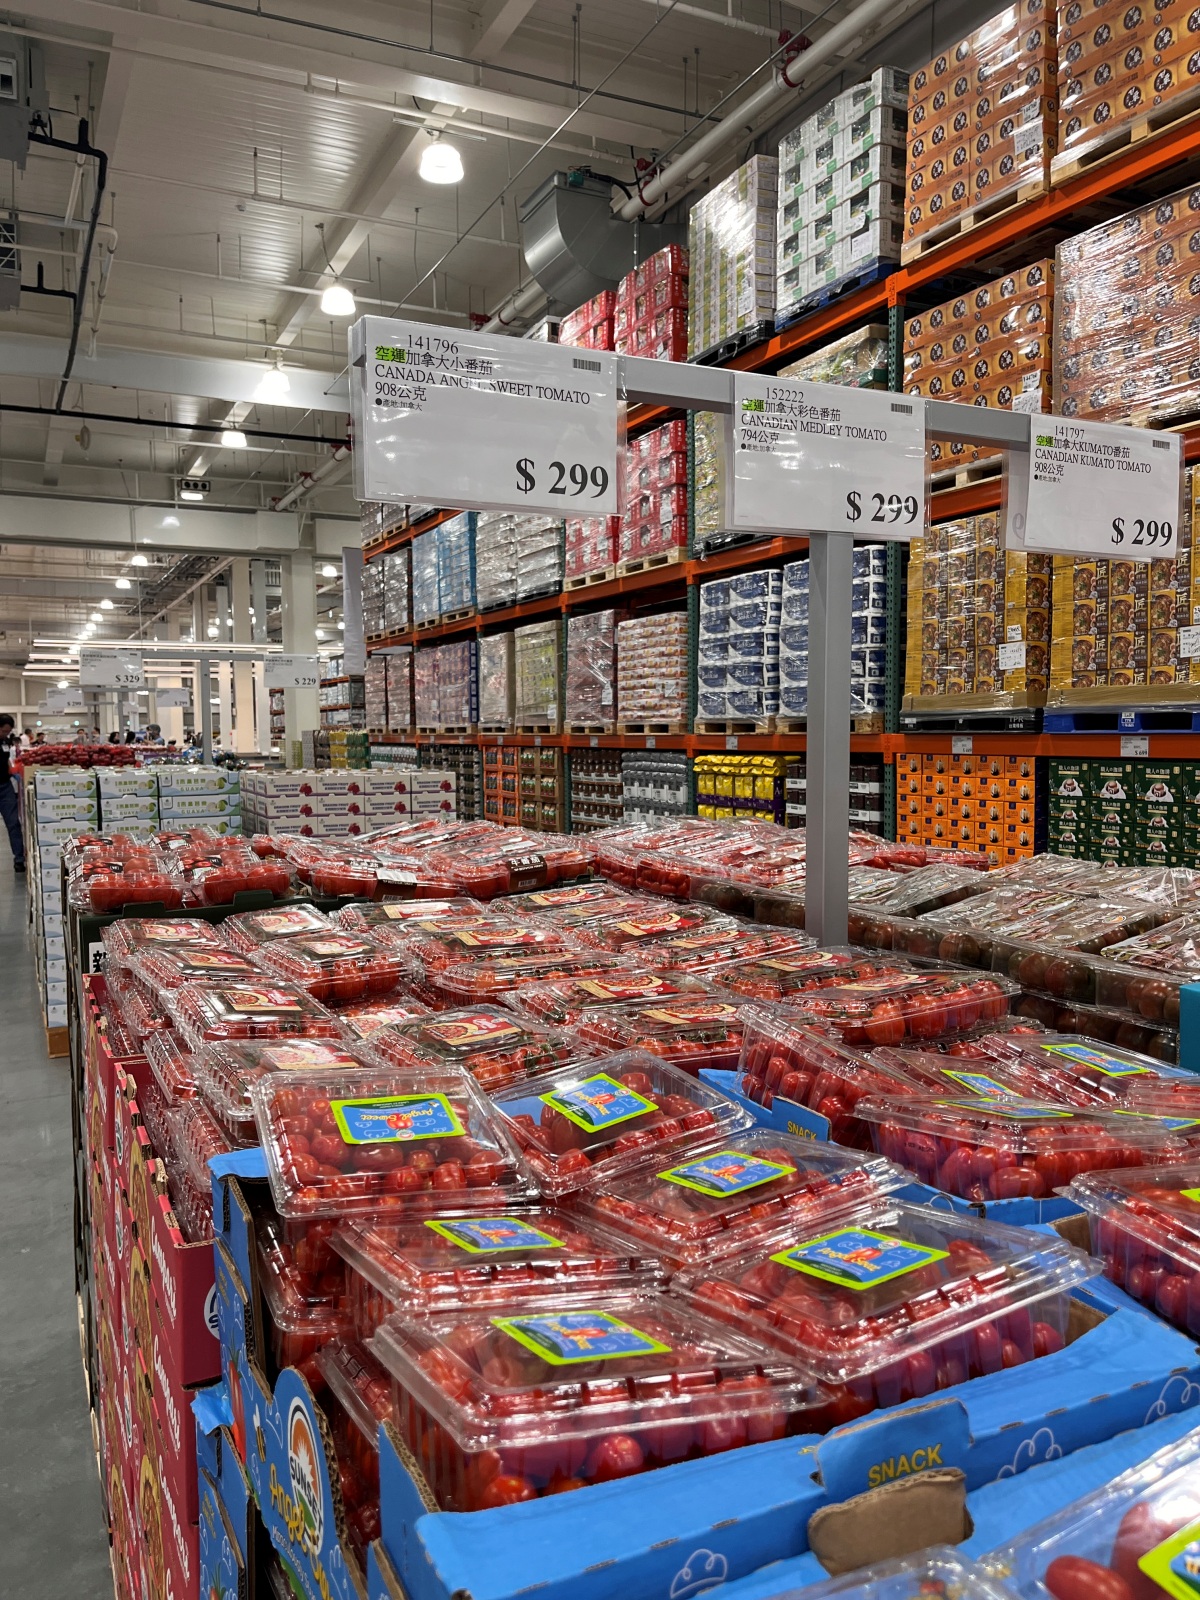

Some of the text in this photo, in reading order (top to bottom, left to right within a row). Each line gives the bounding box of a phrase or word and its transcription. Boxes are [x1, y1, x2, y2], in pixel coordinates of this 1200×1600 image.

[407, 334, 459, 354] 141796
[374, 345, 493, 376] 空運加拿大小番茄
[374, 364, 590, 405] CANADA ANG SWEET TOMATO
[375, 382, 427, 402] 908公克
[766, 387, 804, 404] 152222
[742, 398, 841, 422] 空運加拿大彩色番茄
[741, 414, 887, 442] CANADIAN MEDLEY TOMATO
[741, 429, 780, 444] 794公克
[1054, 426, 1084, 440] 141797
[1036, 435, 1130, 458] 空運加拿大KUMATO番茄
[1034, 462, 1064, 476] 908公克
[1036, 448, 1152, 474] CANADIAN KUMATO TOMATO
[516, 458, 609, 498] $ 299
[846, 490, 918, 524] $ 299
[1112, 517, 1172, 548] $ 299
[122, 674, 140, 684] 329
[302, 678, 316, 686] 229
[401, 1108, 434, 1120] Angel
[788, 1120, 816, 1140] SNACK
[868, 1443, 942, 1487] SNACK
[290, 1458, 323, 1535] SUNSET
[270, 1462, 308, 1557] Angel
